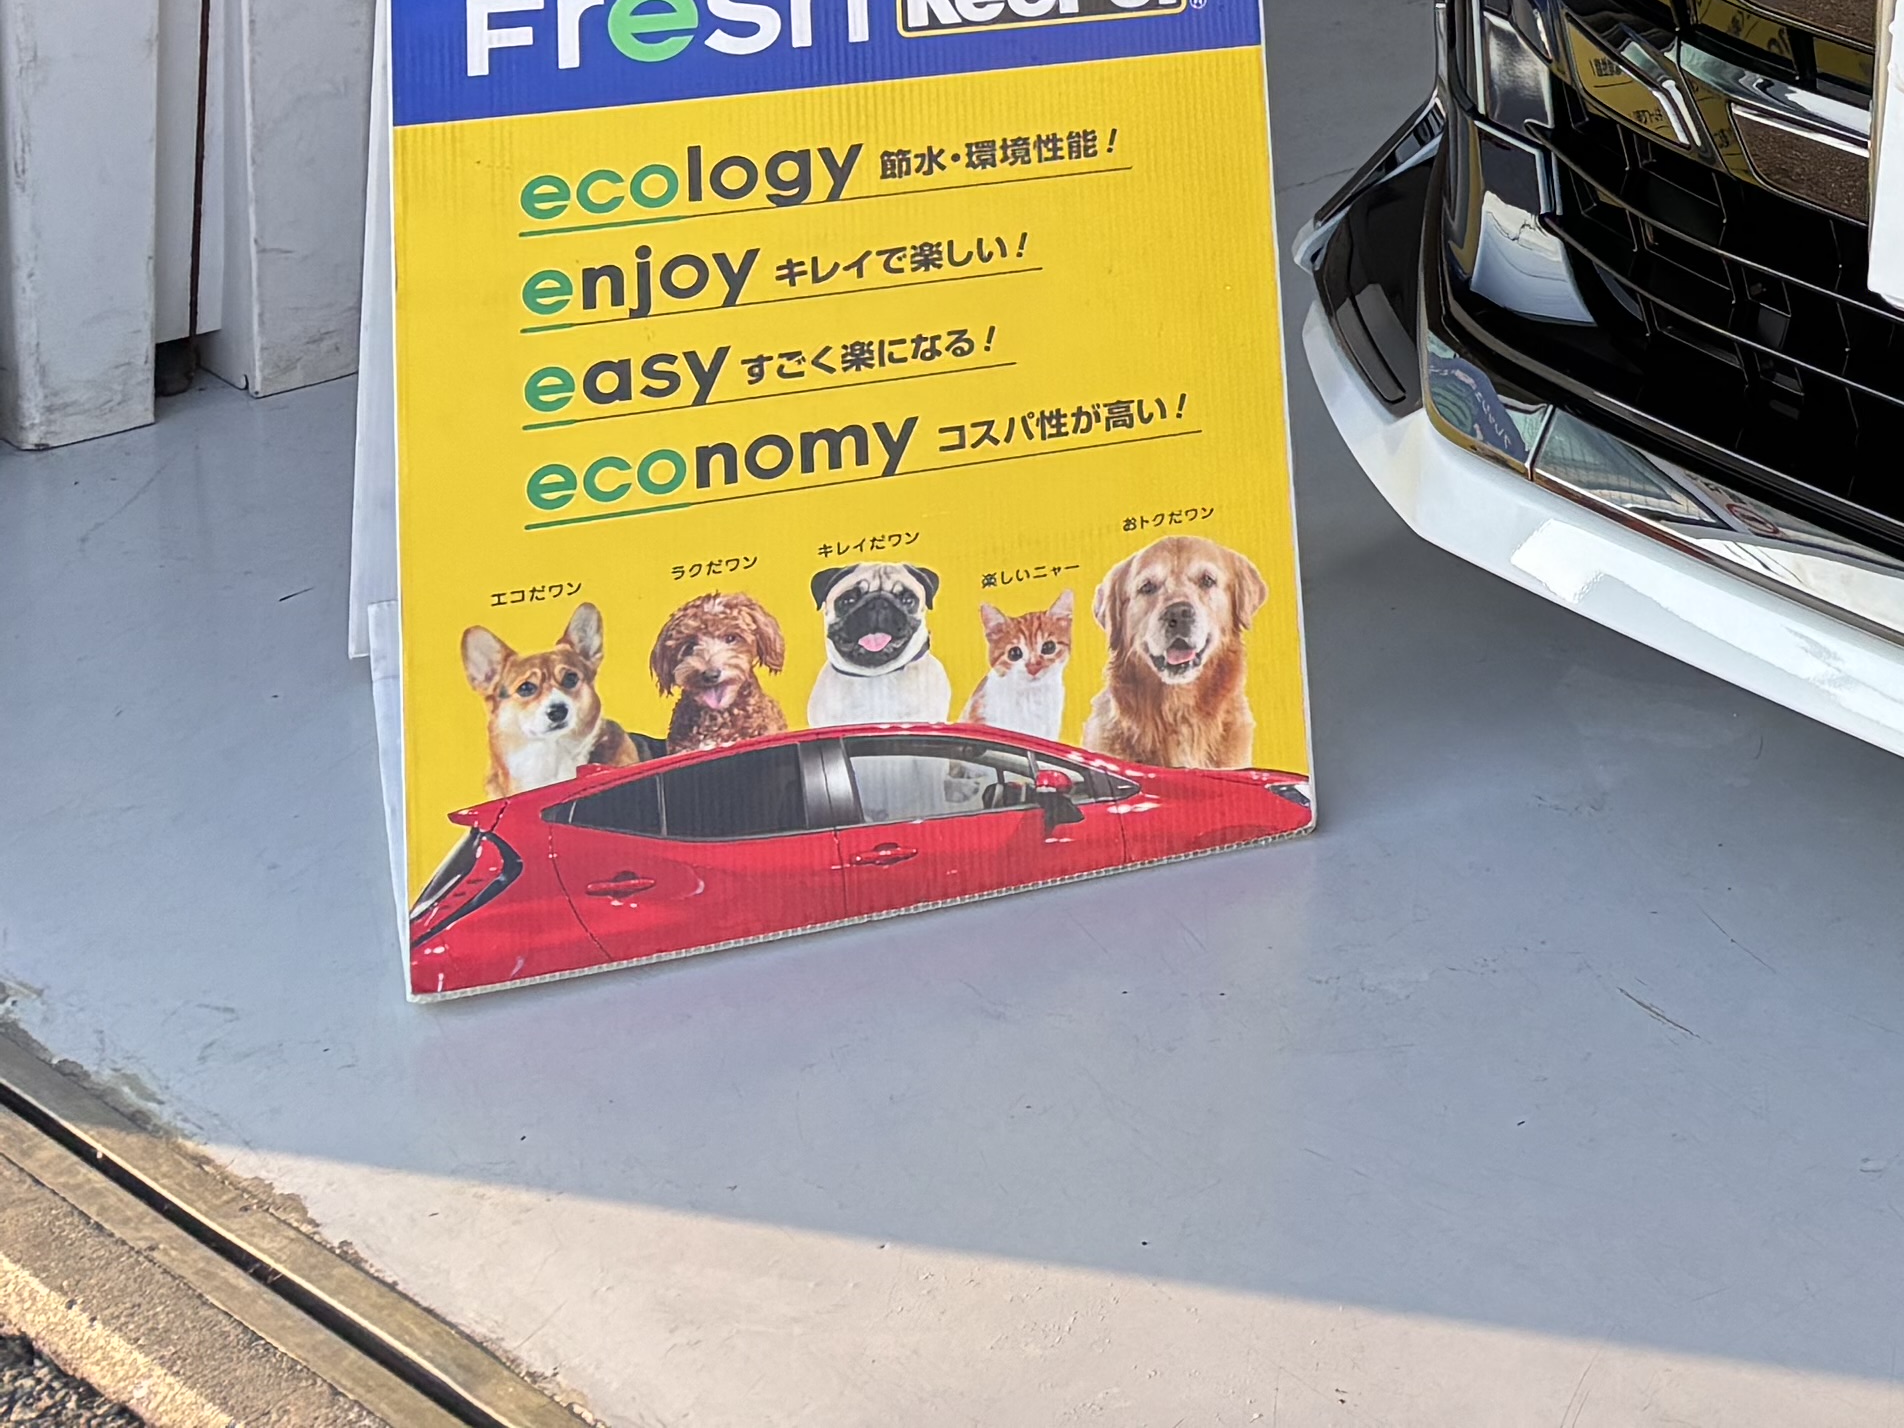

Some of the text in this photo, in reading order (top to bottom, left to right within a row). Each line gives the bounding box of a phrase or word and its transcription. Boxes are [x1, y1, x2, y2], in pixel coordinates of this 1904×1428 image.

[520, 143, 864, 221] ecology
[521, 244, 761, 320] enjoy
[523, 345, 731, 414] easy
[526, 415, 919, 511] economy
[1121, 506, 1216, 533] おトクだワン
[817, 531, 920, 559] キレイだワン
[671, 556, 758, 581] ラクだワン
[980, 563, 1081, 590] 楽しいニャー
[490, 581, 583, 607] エコだワン
